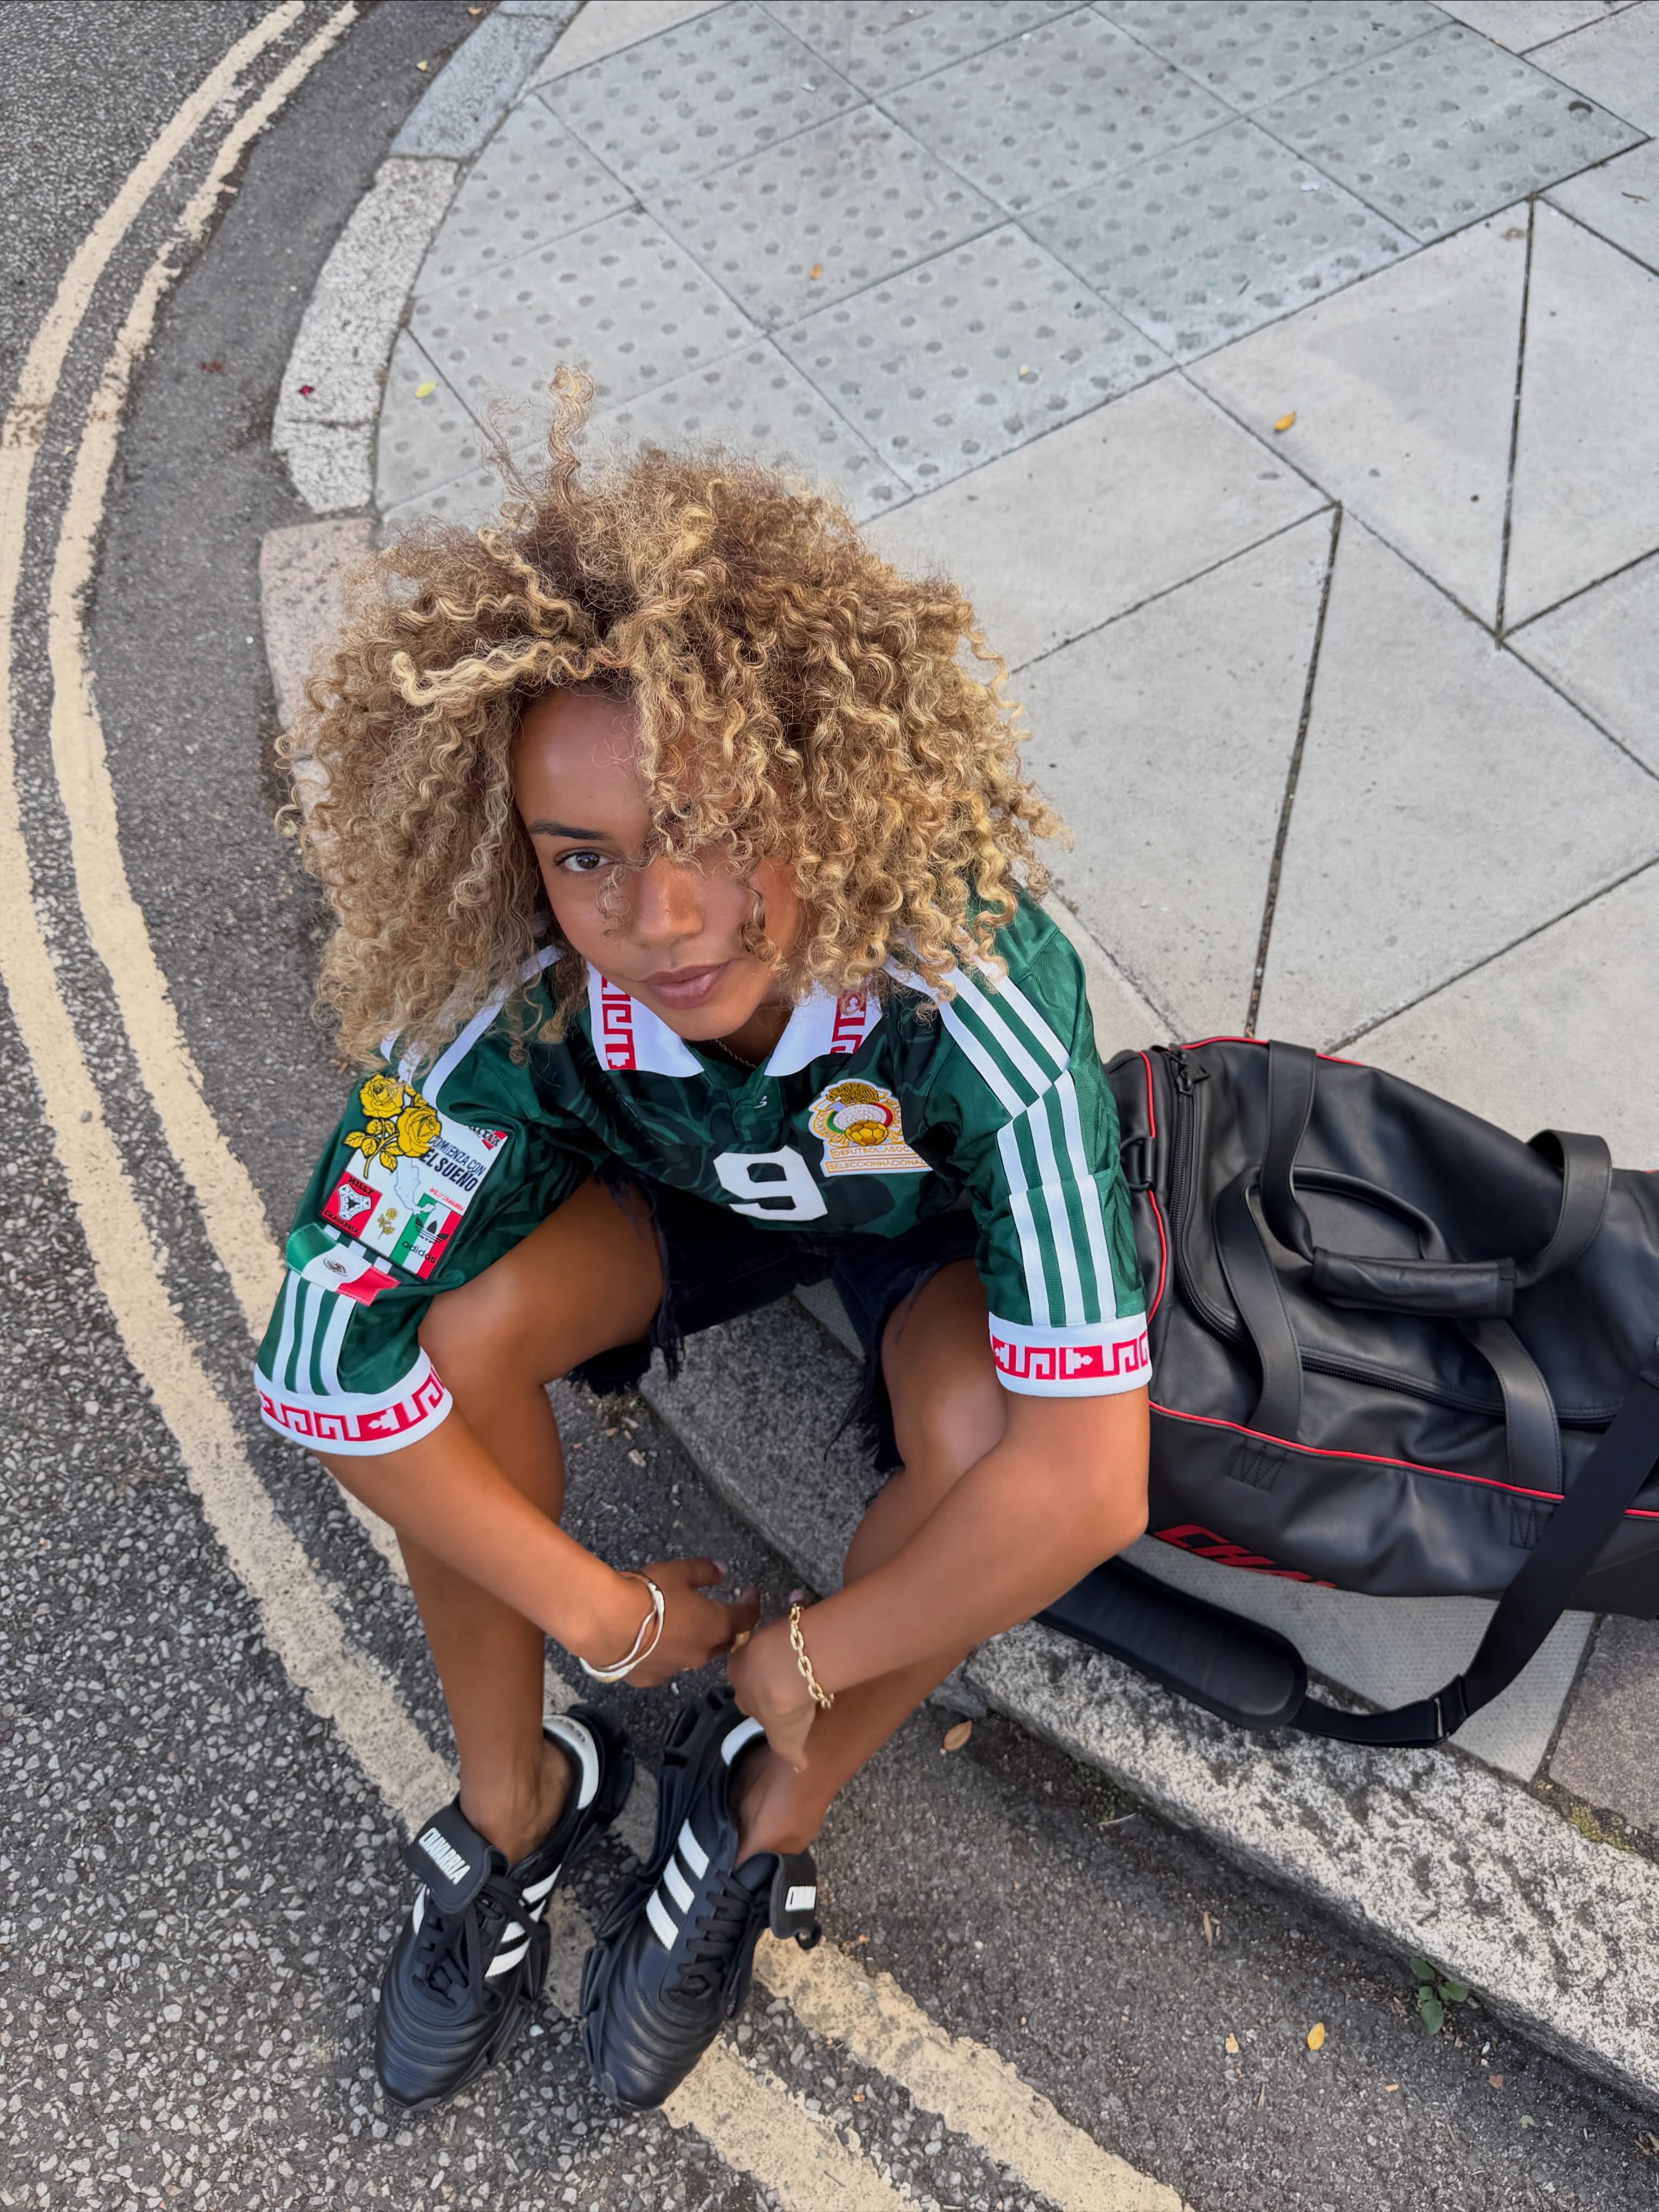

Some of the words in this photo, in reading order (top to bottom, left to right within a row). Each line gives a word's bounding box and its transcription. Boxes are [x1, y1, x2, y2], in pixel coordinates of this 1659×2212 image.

[419, 1148, 439, 1168] EL
[427, 1135, 470, 1166] COMIENZA
[467, 1159, 486, 1177] CON
[713, 1145, 828, 1221] 9
[402, 1240, 436, 1264] adidas
[419, 1827, 471, 1885] CHAVARRIA
